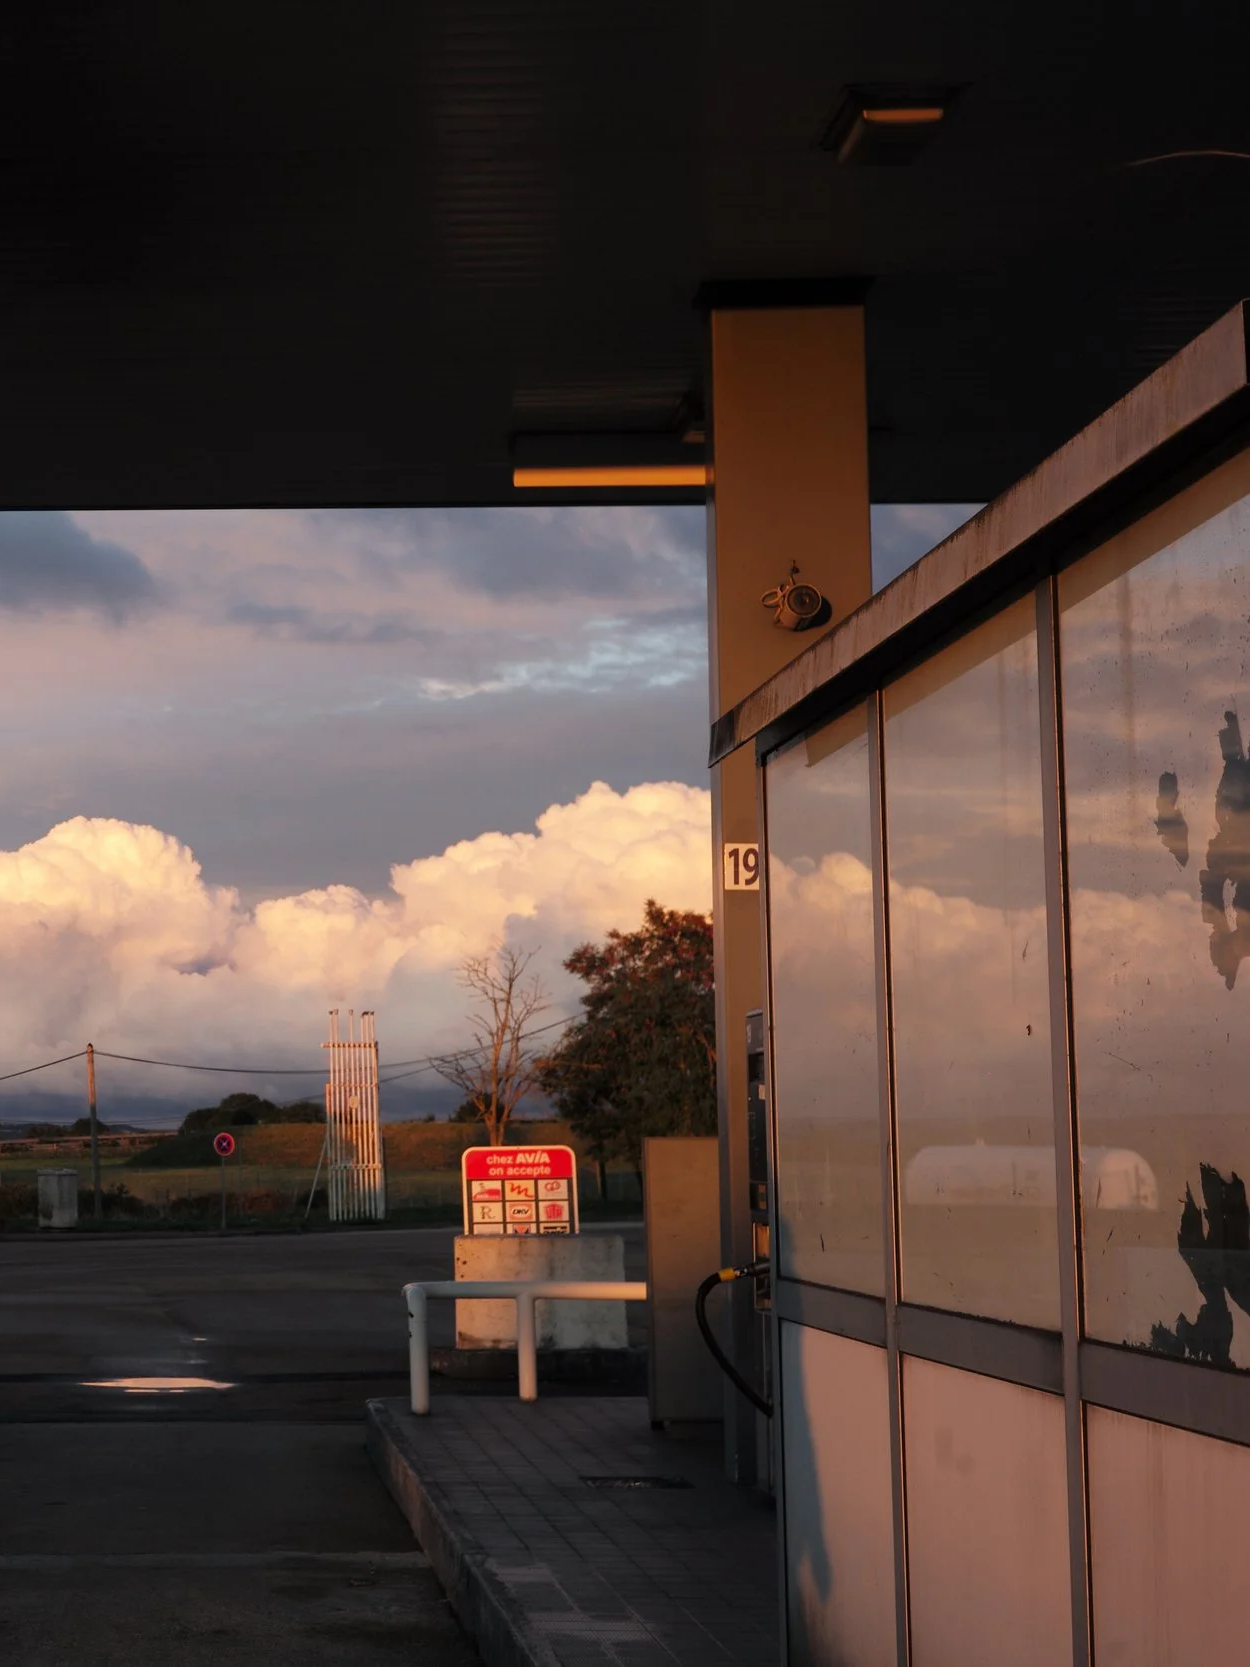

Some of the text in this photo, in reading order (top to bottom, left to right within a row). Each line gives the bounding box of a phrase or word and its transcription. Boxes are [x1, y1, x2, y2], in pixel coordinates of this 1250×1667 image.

[728, 847, 759, 886] 19
[486, 1151, 550, 1164] chez AVIA
[488, 1165, 551, 1177] on accepte
